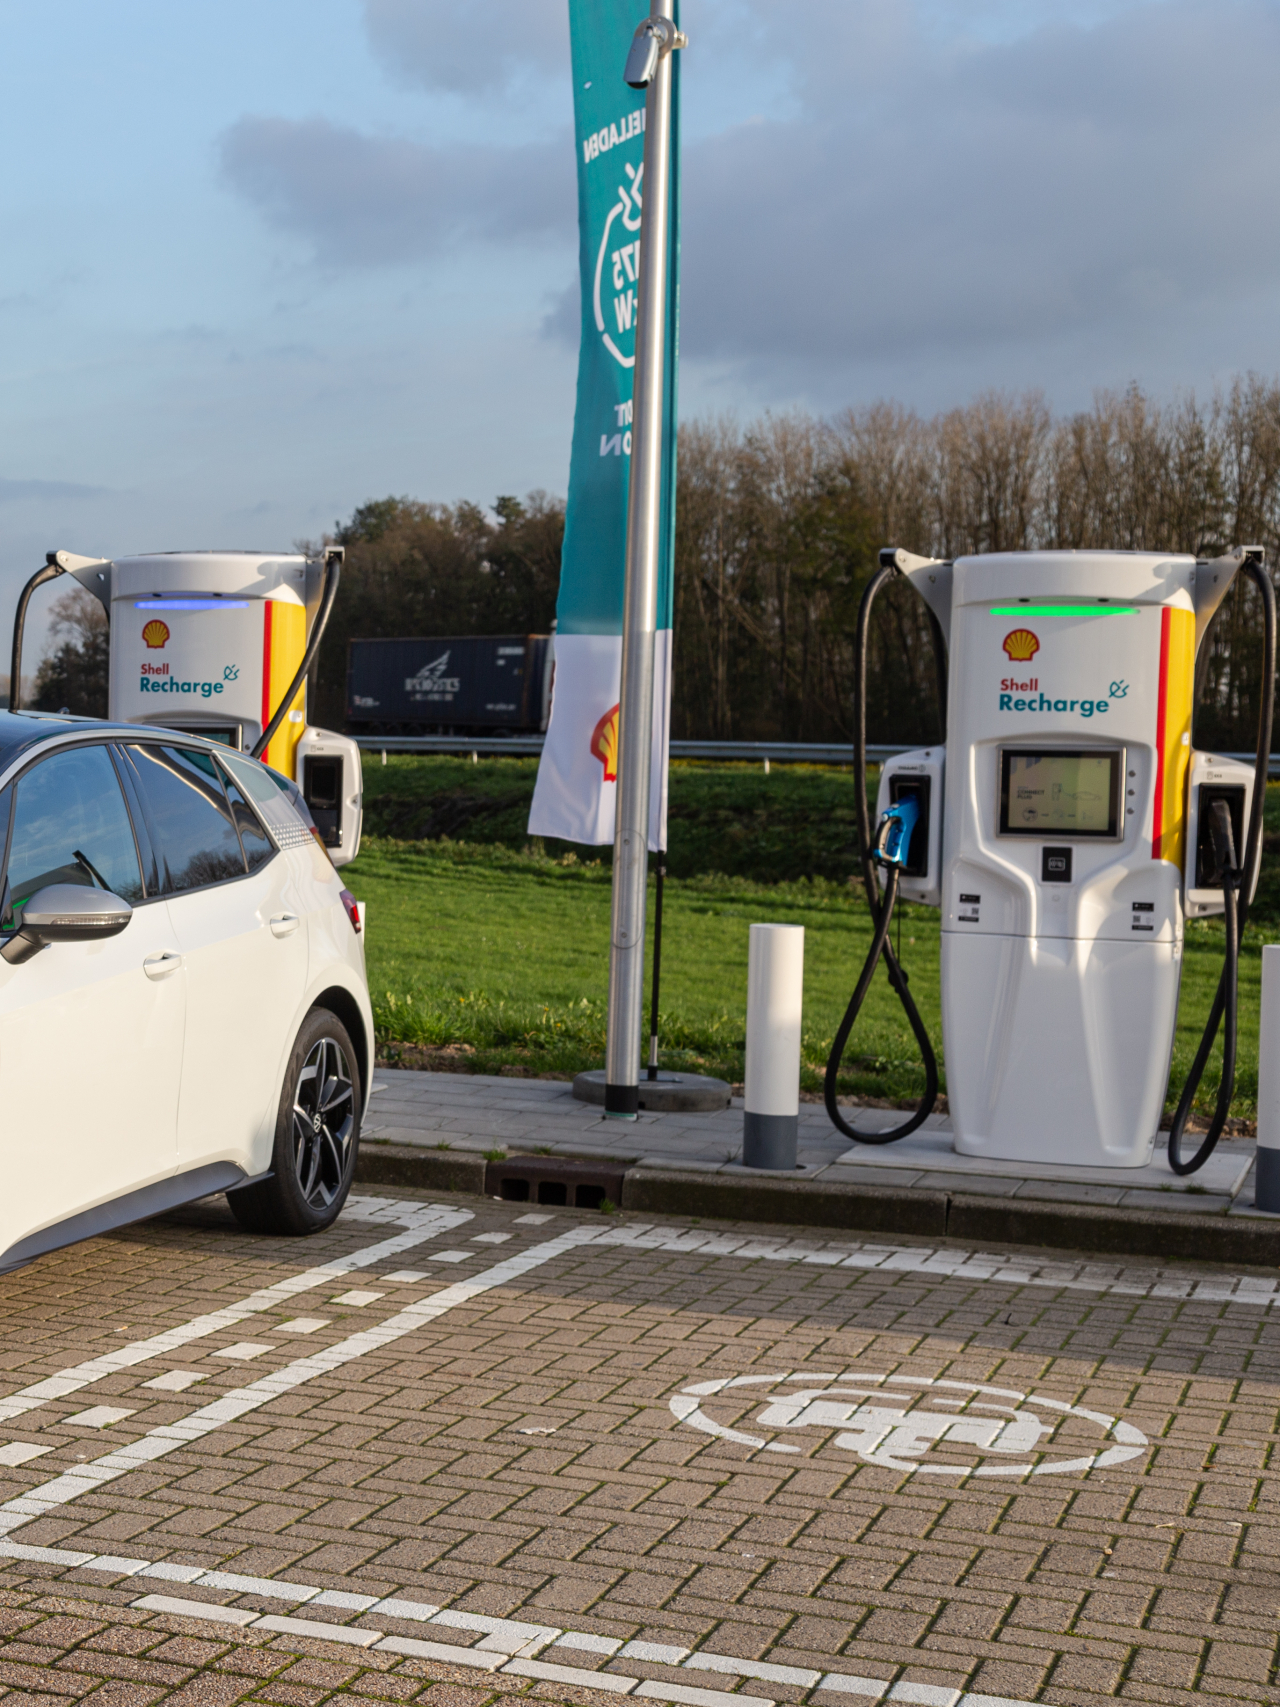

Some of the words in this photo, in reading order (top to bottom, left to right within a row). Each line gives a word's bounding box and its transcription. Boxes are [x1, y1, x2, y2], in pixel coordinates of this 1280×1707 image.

[141, 663, 169, 675] Shell
[140, 676, 224, 698] Recharge
[1000, 678, 1038, 691] Shell
[999, 693, 1109, 717] Recharge
